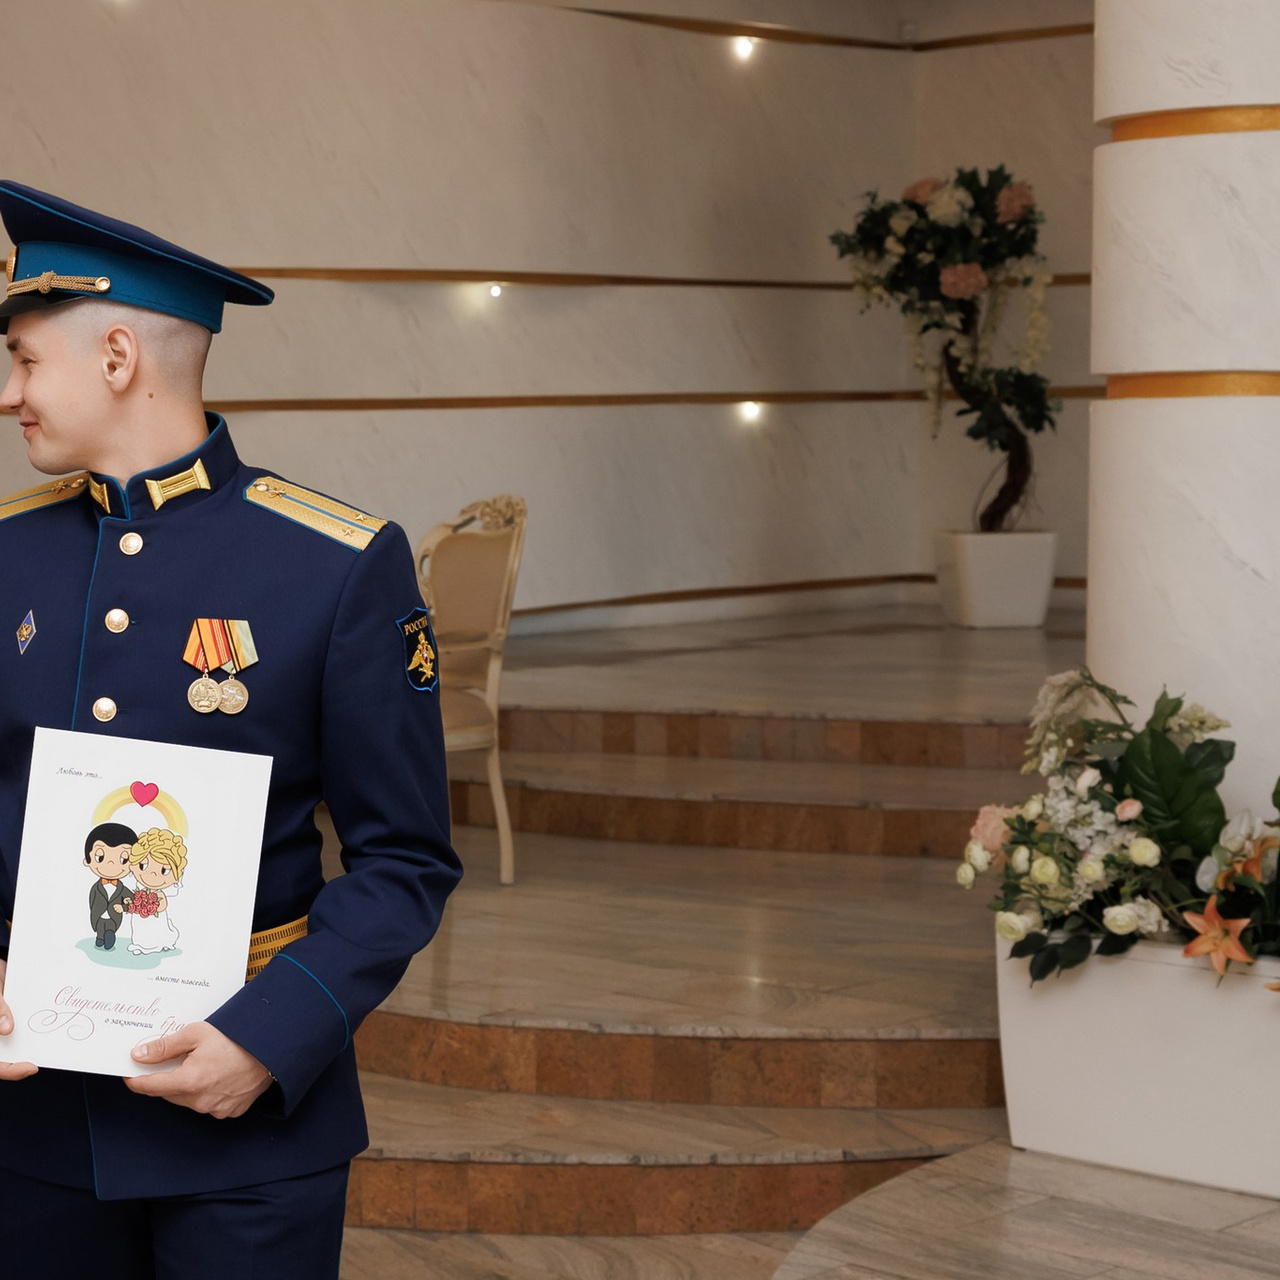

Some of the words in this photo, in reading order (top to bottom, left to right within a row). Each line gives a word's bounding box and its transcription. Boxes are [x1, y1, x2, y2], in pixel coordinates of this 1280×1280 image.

[55, 767, 83, 776] Любовь
[54, 985, 161, 1026] Свидетельство
[110, 1019, 153, 1028] заключении
[160, 1015, 185, 1039] бра
